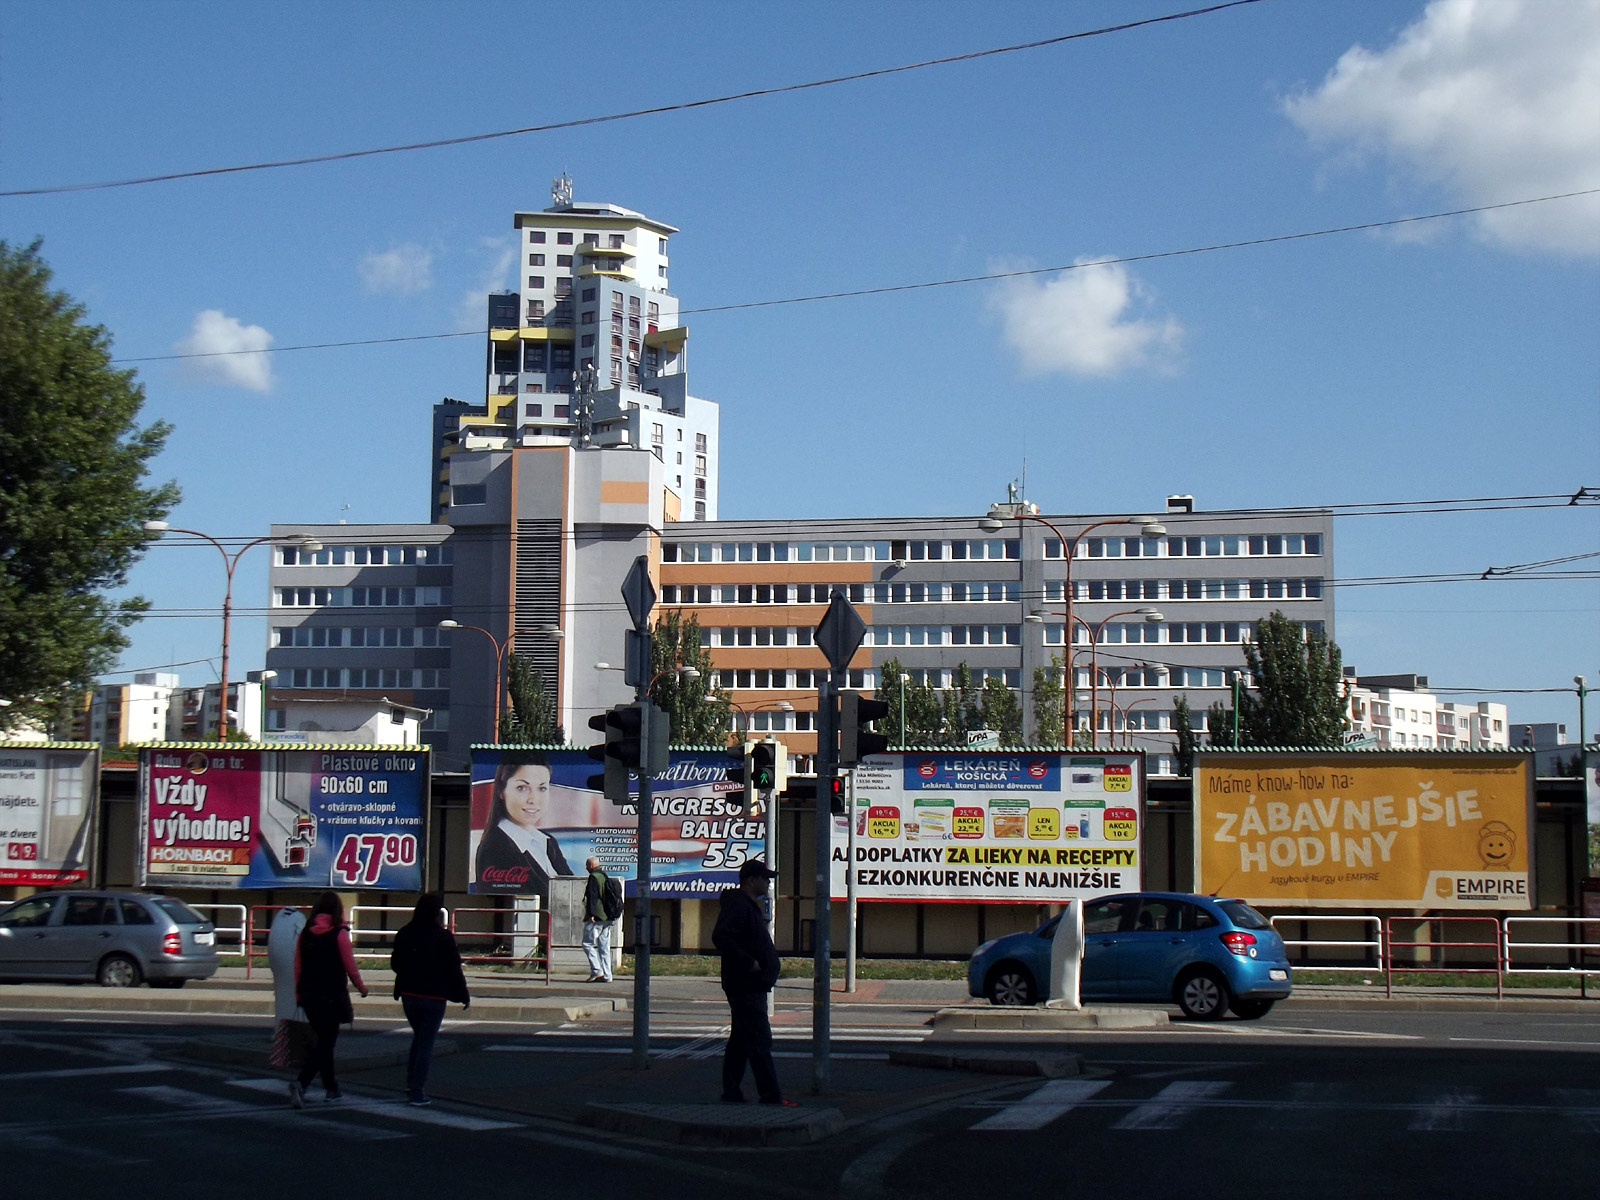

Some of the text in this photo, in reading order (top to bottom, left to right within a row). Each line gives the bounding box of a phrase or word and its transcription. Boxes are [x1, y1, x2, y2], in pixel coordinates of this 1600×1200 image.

[213, 758, 224, 769] na
[321, 754, 416, 771] Plastové okno
[944, 759, 1020, 772] LEKÁREŇ
[957, 771, 1008, 781] KOŠICKÁ
[1209, 770, 1354, 793] Máme know-how na:
[154, 775, 207, 811] Vždy
[321, 776, 388, 794] 90x60 cm
[327, 802, 396, 813] otváravo-sklopné
[1214, 781, 1482, 842] ZÁBAVNEJŠIE
[153, 811, 250, 845] výhodne!
[327, 816, 357, 825] vrátane
[359, 816, 385, 826] kľučky
[10, 829, 38, 838] dvere
[152, 849, 233, 862] HORNBACH
[703, 843, 747, 868] 55
[856, 848, 943, 863] DOPLATKY
[947, 848, 970, 863] ZA
[974, 849, 1023, 863] LIEKY
[1028, 849, 1051, 864] NA
[1056, 850, 1135, 865] RECEPTY
[1240, 831, 1398, 872] HODINY
[845, 866, 1121, 888] EZKONKURENČNE NAJNIŽŠIE
[1269, 873, 1309, 886] Jazykové
[1312, 873, 1336, 885] kurzy
[1345, 872, 1380, 881] EMPIRE
[1457, 879, 1526, 894] EMPIRE
